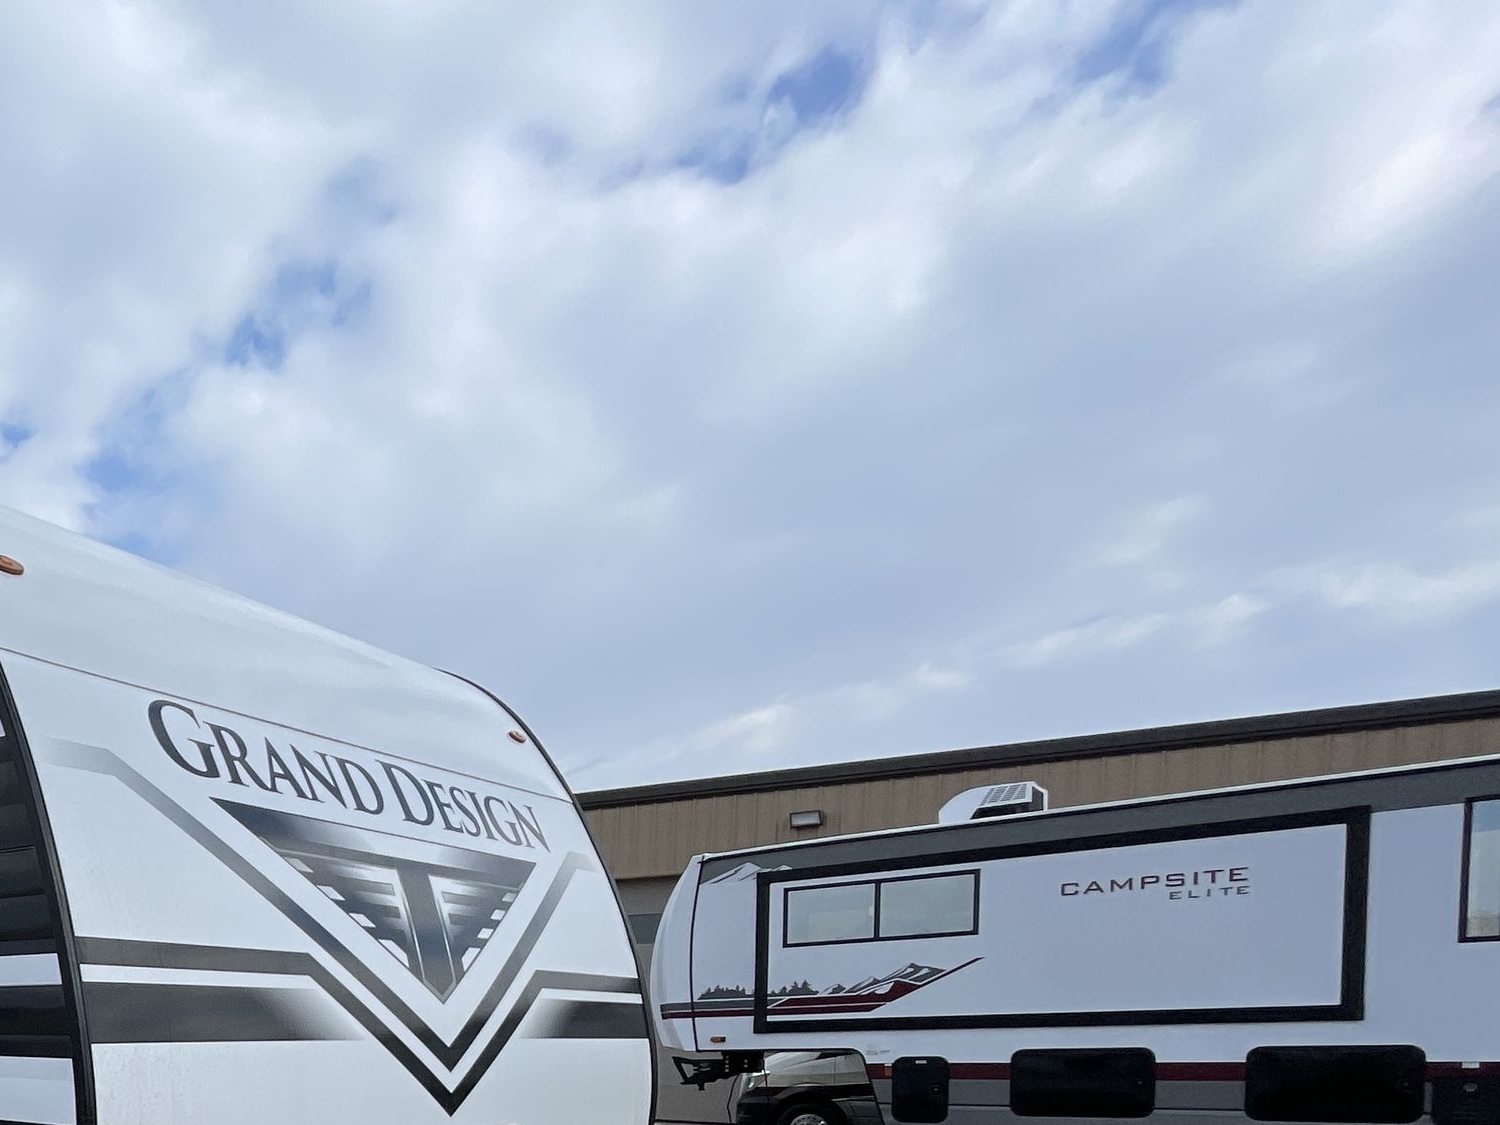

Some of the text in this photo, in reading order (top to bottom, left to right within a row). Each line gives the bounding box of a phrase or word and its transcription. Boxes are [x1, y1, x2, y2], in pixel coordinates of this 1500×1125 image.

[147, 699, 551, 853] GRAND DESIGN
[1060, 866, 1250, 897] CAMPSITE
[1168, 885, 1250, 900] ELITE
